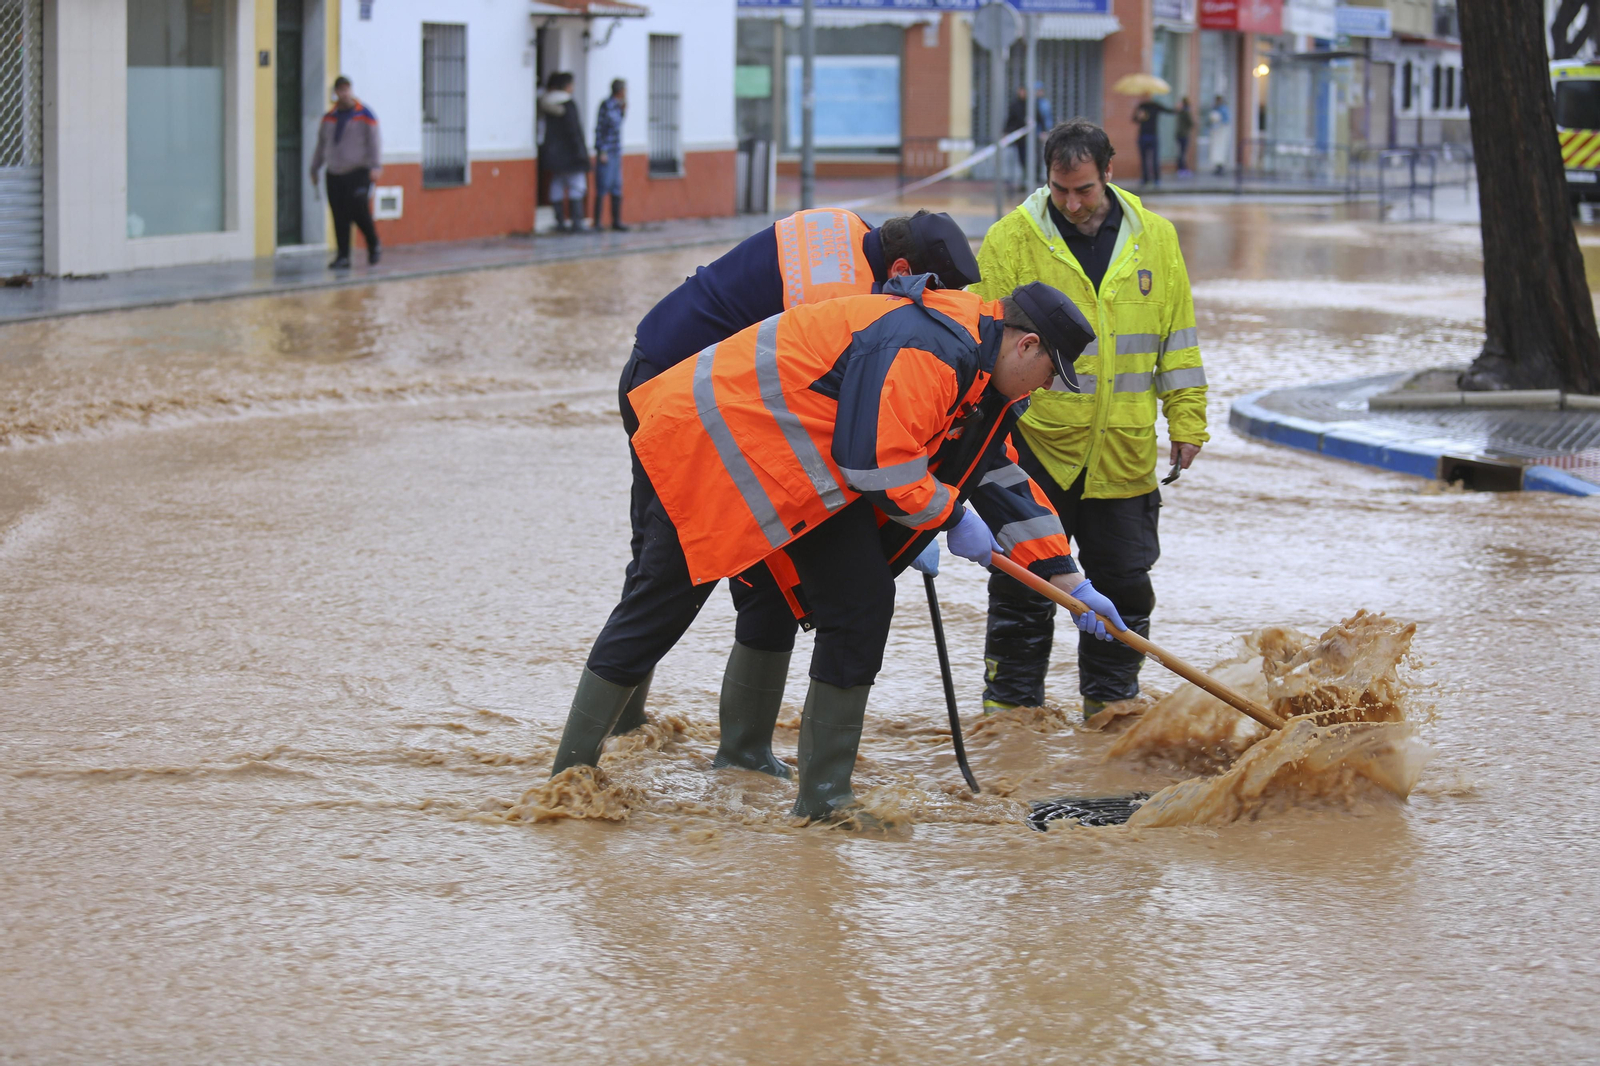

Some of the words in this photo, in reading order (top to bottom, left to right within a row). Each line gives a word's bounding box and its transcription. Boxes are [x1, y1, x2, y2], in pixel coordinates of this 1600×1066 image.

[806, 221, 823, 268] MÁLAGA
[821, 228, 836, 258] CIVIL
[832, 212, 852, 283] PROTECCIÓN
